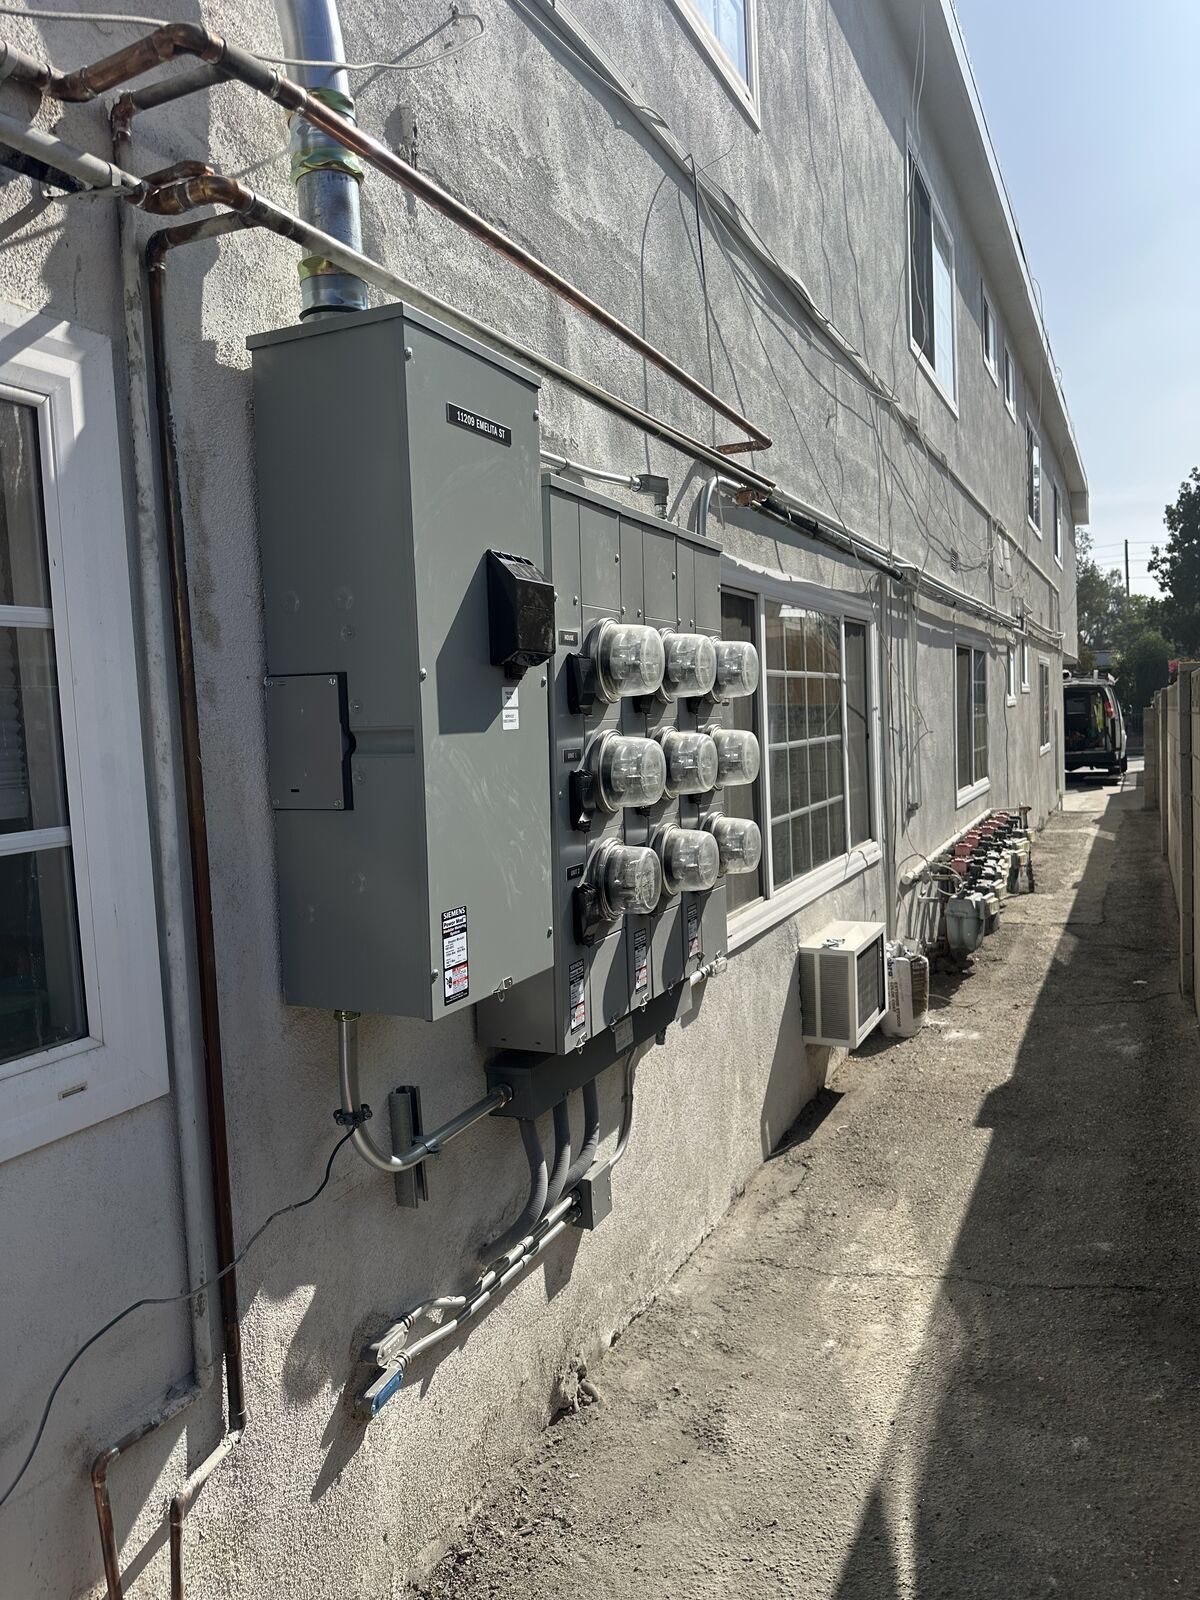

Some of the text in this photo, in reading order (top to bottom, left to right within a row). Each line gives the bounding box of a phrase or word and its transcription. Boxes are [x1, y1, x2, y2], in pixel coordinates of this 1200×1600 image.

[457, 411, 505, 439] 11209 EMELITA ST
[443, 907, 465, 919] SIEMENS
[443, 919, 456, 928] Power
